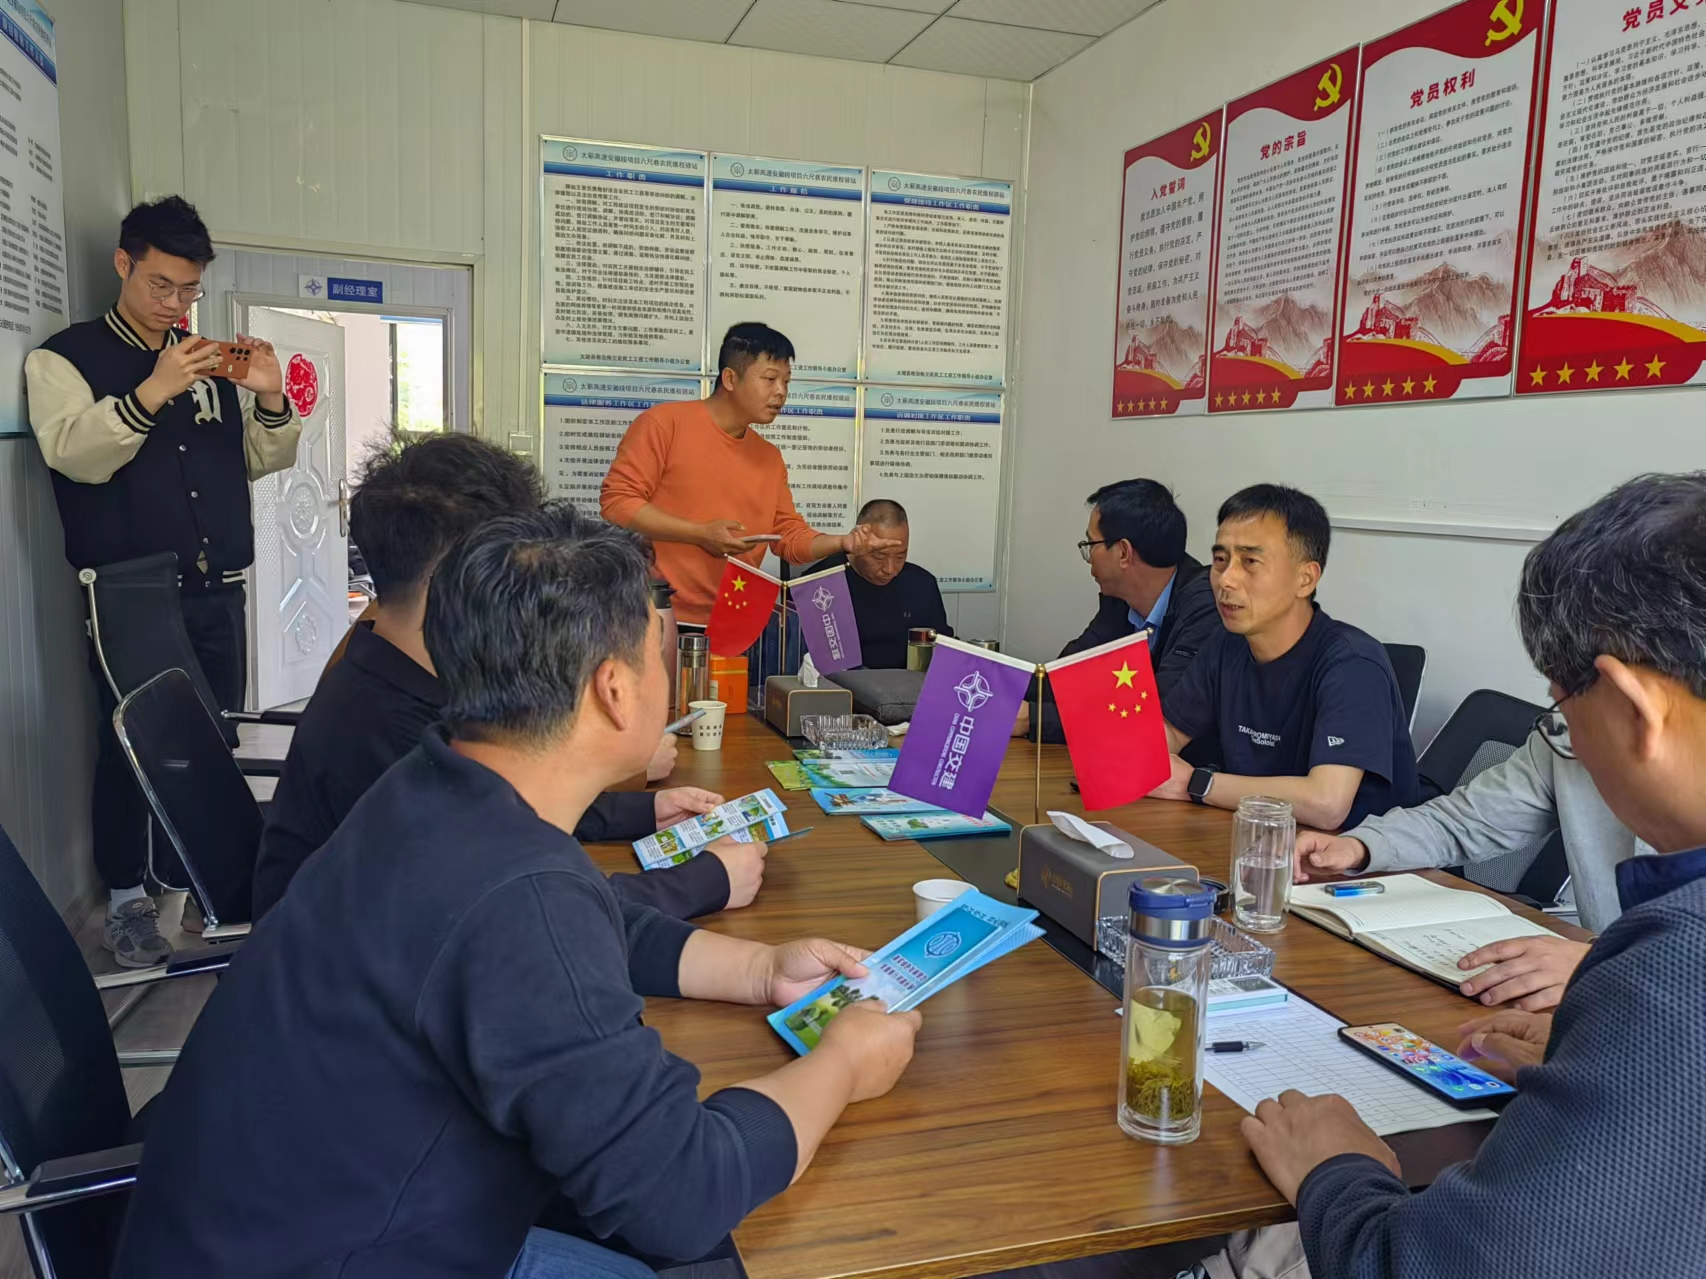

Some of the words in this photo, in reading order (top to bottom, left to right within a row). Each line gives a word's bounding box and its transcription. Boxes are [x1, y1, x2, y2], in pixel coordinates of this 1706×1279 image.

[1622, 0, 1706, 32] 党员义
[1410, 68, 1475, 109] 党员权利
[1260, 130, 1306, 160] 党的宗旨
[606, 170, 646, 181] 工作职责
[1151, 177, 1186, 200] 入党誓词
[332, 284, 378, 297] 副经理室
[939, 716, 974, 789] 中国交建
